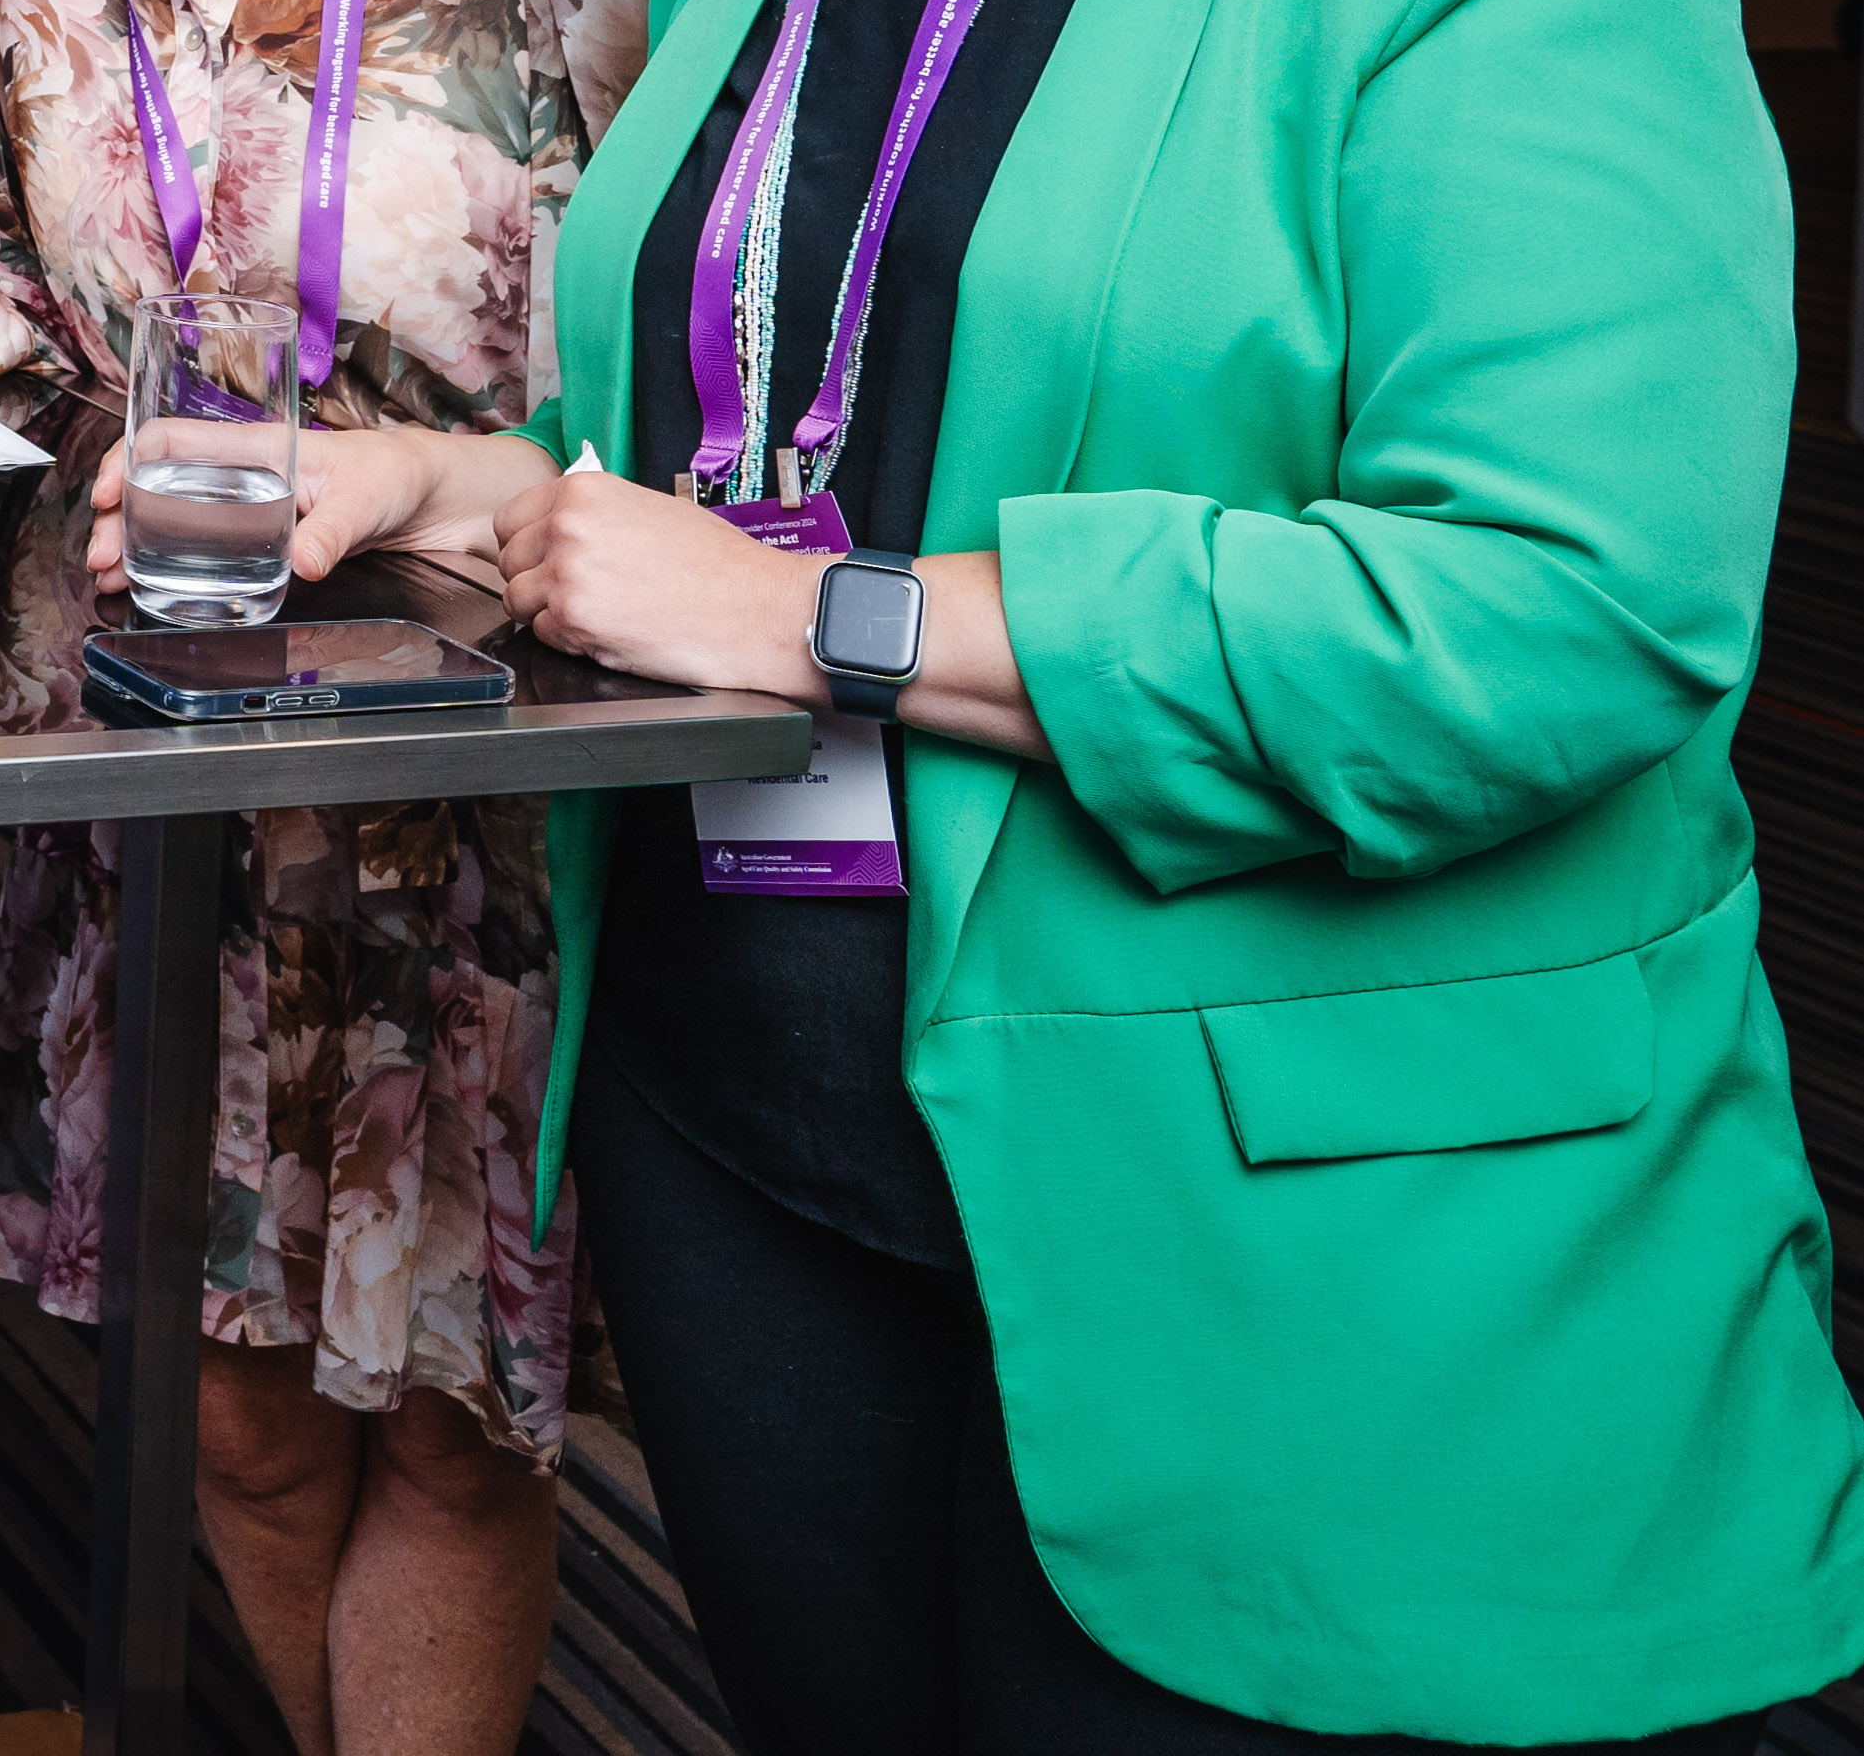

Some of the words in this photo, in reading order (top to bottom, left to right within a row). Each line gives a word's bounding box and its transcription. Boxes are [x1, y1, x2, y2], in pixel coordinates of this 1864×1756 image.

[777, 11, 805, 69] Working
[138, 72, 149, 89] for
[331, 47, 346, 96] together
[143, 89, 163, 136] together
[328, 96, 342, 115] for
[755, 69, 785, 125] together
[324, 114, 339, 150] better
[746, 126, 762, 146] for
[869, 168, 894, 232] Working
[888, 102, 916, 167] together
[910, 78, 926, 101] for
[918, 29, 945, 77] better
[156, 136, 176, 184] Working
[320, 151, 333, 180] aged
[732, 147, 754, 191] better
[319, 183, 330, 209] care
[722, 192, 737, 226] aged
[711, 227, 726, 259] care
[762, 536, 779, 546] the
[779, 533, 798, 545] Act!
[764, 521, 800, 531] Conference
[800, 518, 817, 526] 2024
[811, 546, 831, 555] care
[805, 772, 829, 783] Care
